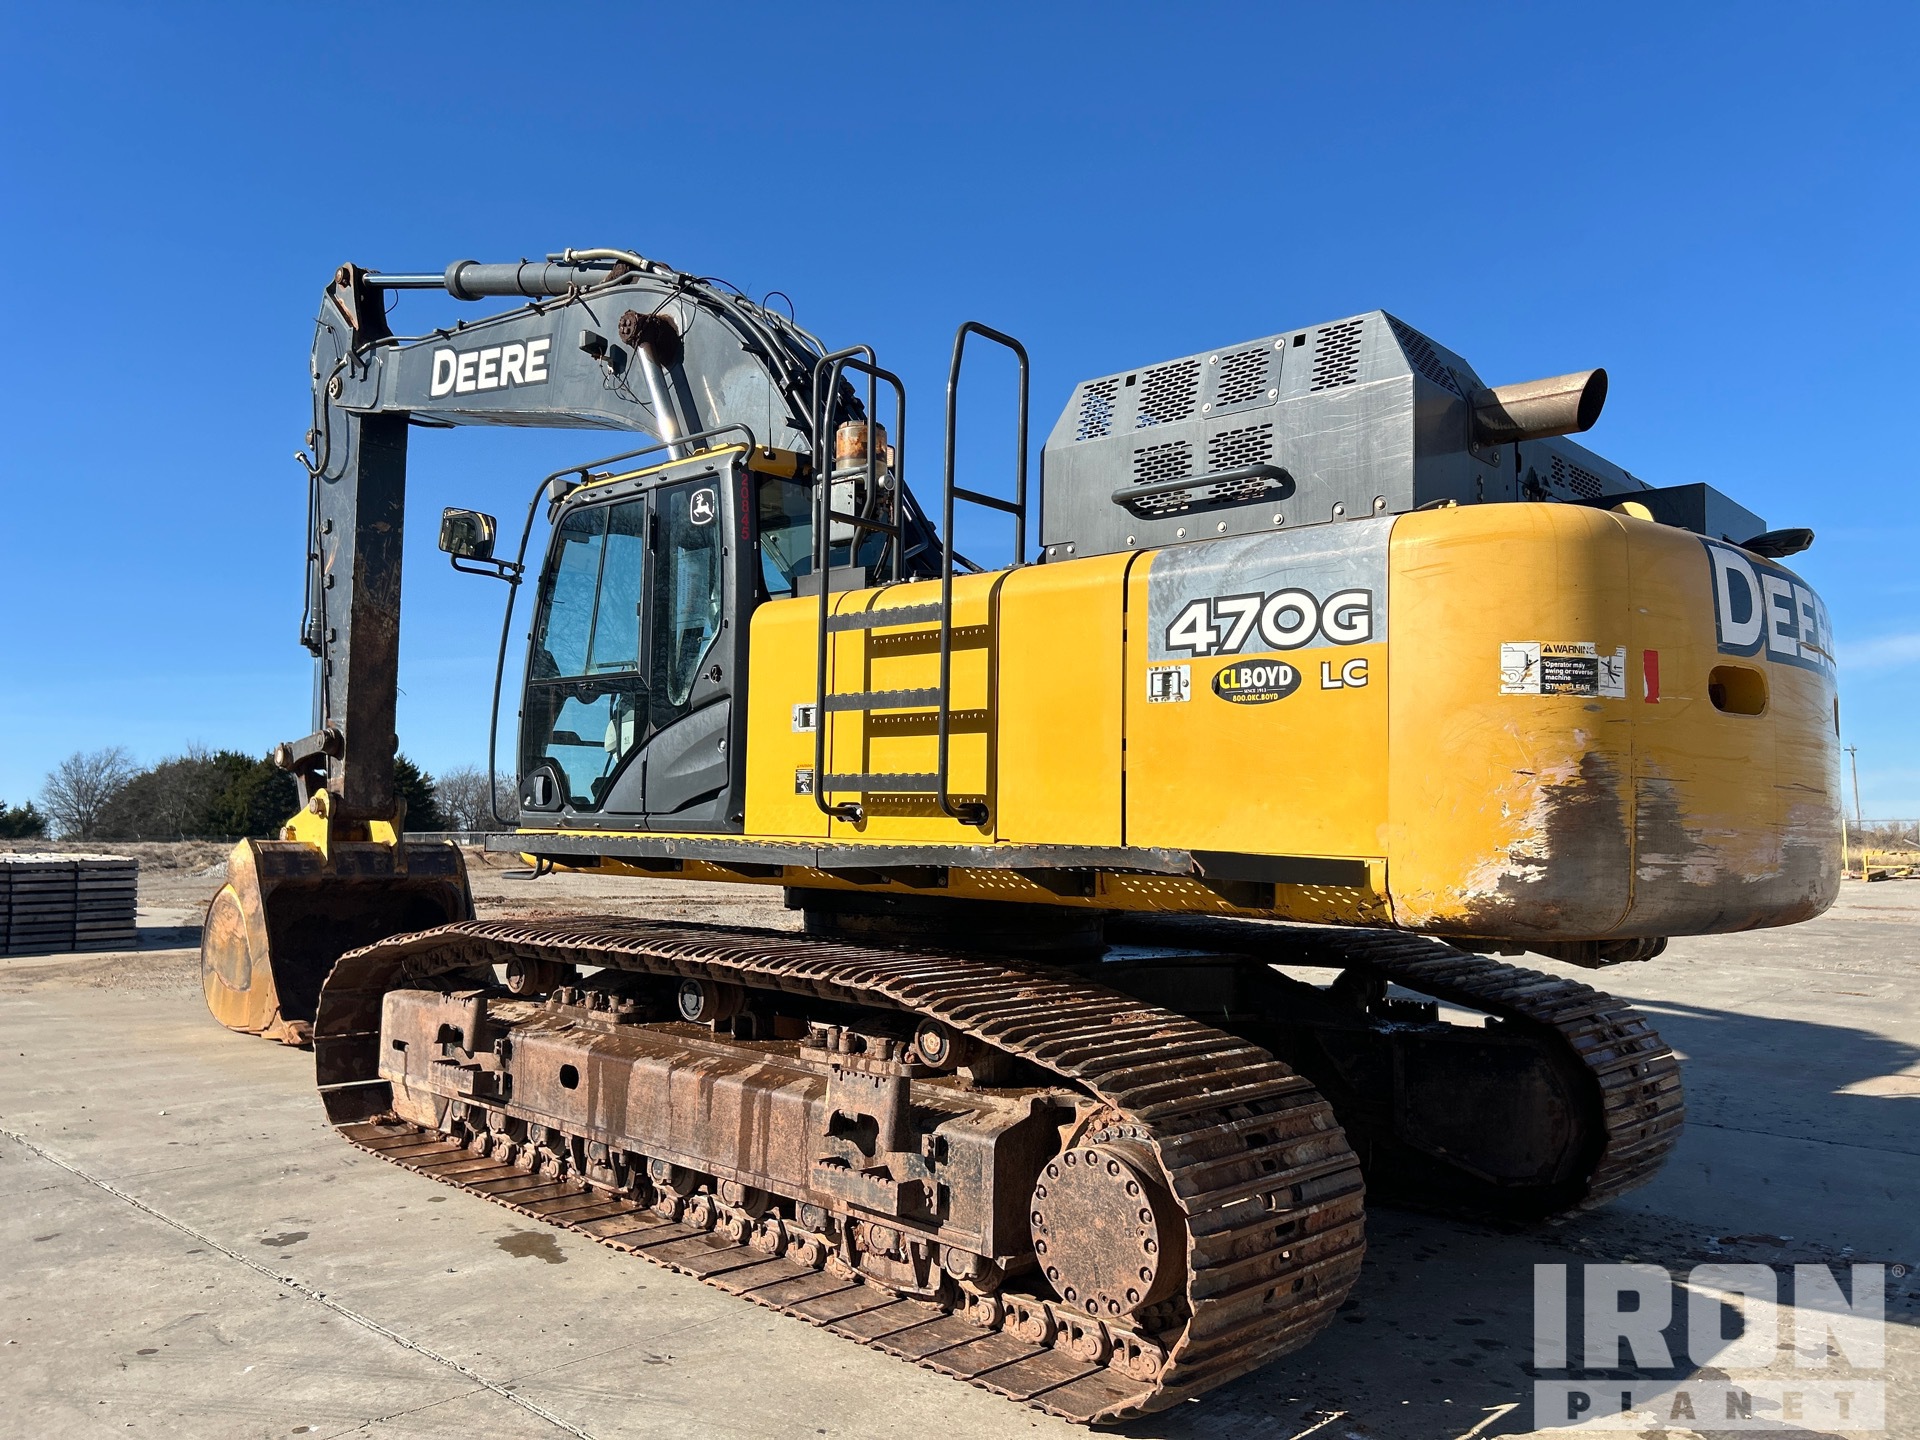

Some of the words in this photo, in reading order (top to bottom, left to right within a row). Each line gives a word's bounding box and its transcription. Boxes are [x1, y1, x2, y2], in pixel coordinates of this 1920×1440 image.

[430, 338, 550, 397] DEERE
[740, 473, 749, 540] 20845
[1166, 588, 1372, 657] 470G
[1321, 658, 1369, 690] LC
